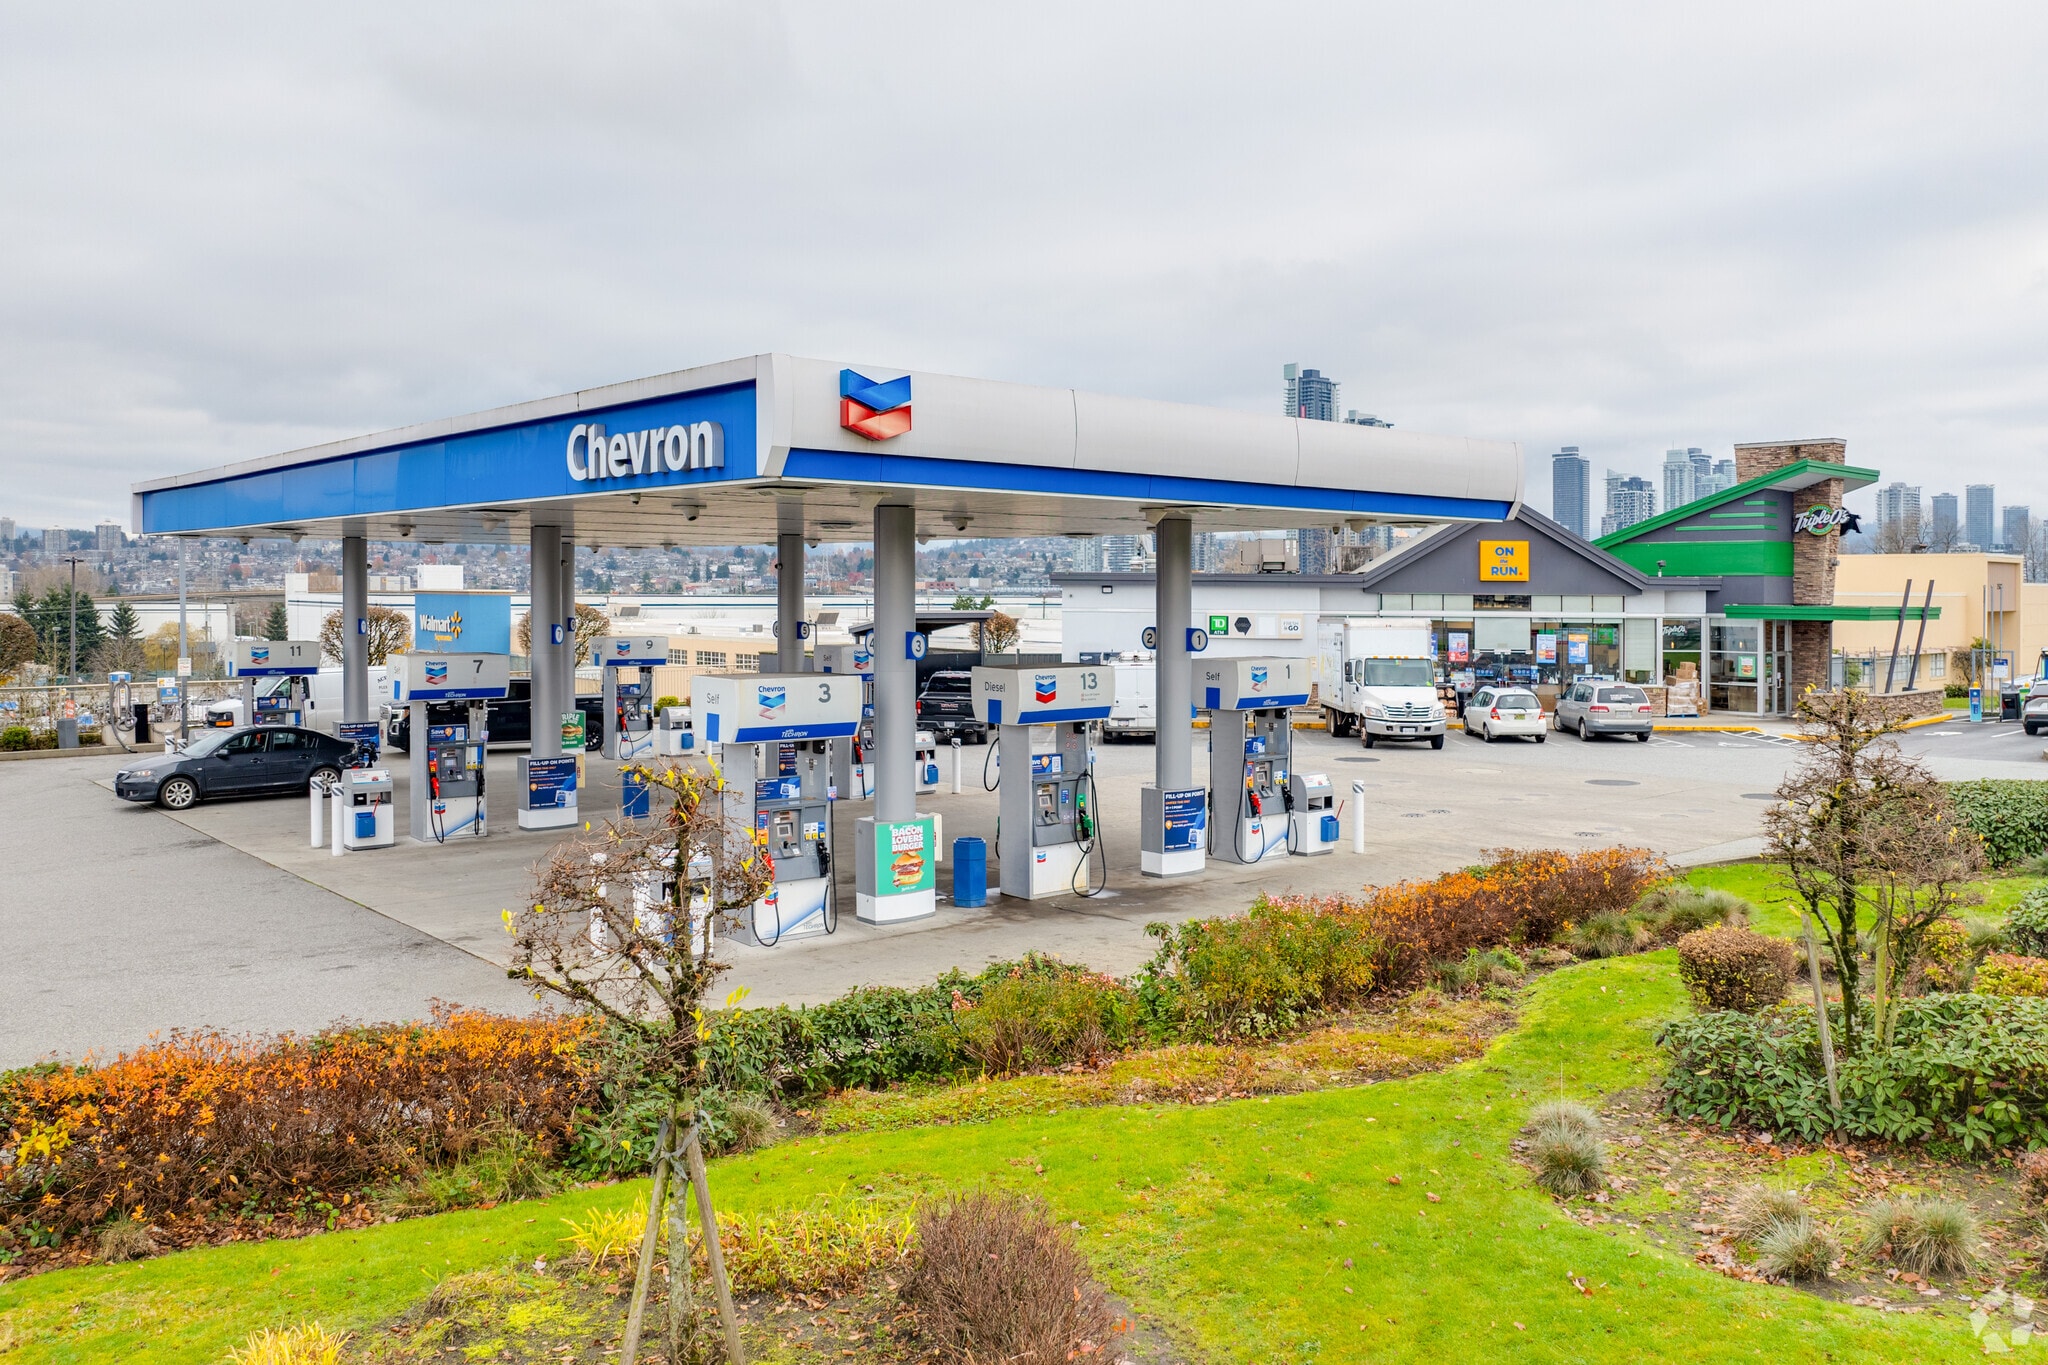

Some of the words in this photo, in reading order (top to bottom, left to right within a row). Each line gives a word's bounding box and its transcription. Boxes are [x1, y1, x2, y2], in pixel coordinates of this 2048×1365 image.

[567, 421, 724, 481] Chevron
[1495, 546, 1514, 556] ON
[420, 614, 451, 632] Walmart
[1213, 619, 1225, 628] TD
[803, 626, 808, 635] 5
[1147, 633, 1153, 643] 2
[1197, 635, 1201, 645] 1
[646, 640, 653, 649] 9
[916, 640, 921, 652] 3
[290, 646, 302, 657] 11
[473, 660, 483, 673] 7
[1286, 665, 1291, 679] 1
[1081, 673, 1097, 690] 13
[1206, 672, 1220, 681] Self
[818, 683, 831, 703] 3
[985, 682, 1005, 693] Diesel
[707, 693, 720, 704] Self
[892, 825, 923, 836] BACON
[892, 834, 923, 844] LOVERS
[892, 842, 923, 851] BURGER
